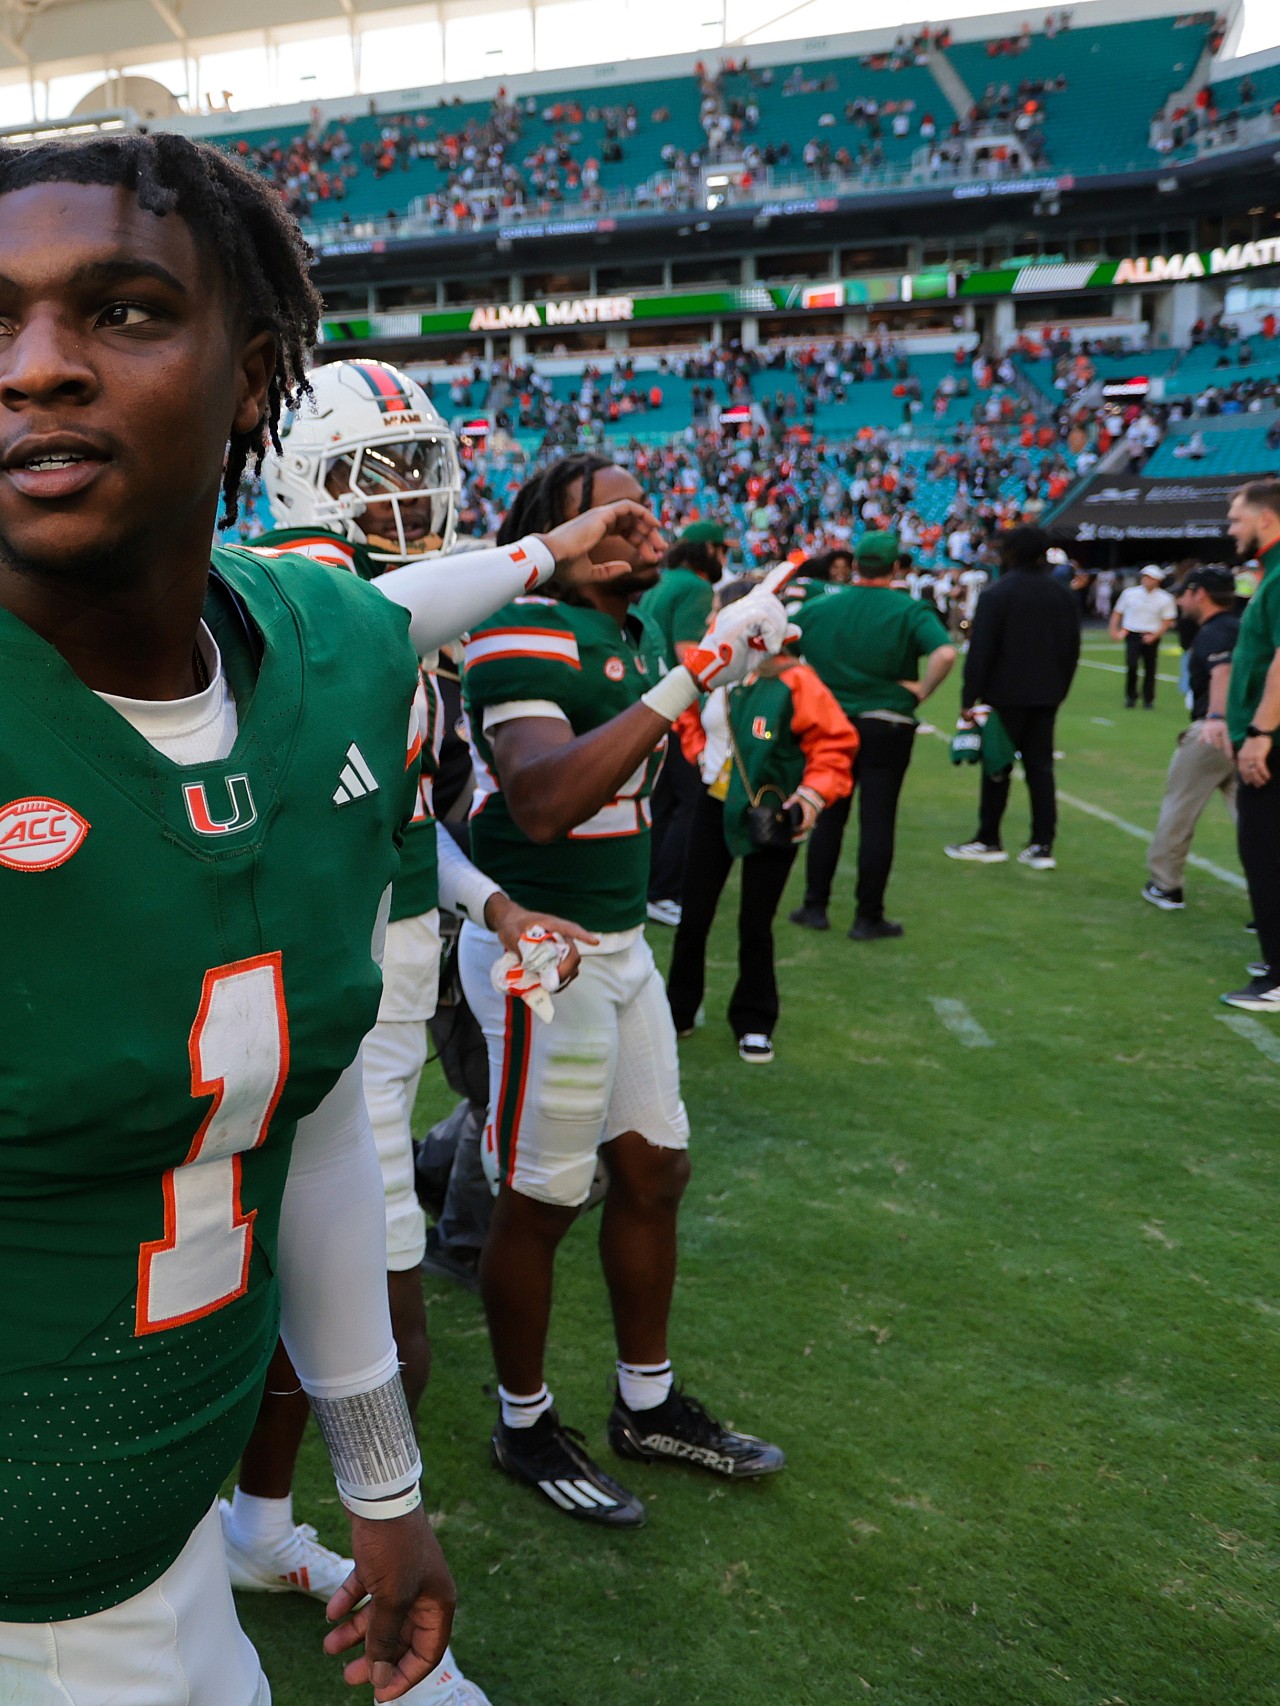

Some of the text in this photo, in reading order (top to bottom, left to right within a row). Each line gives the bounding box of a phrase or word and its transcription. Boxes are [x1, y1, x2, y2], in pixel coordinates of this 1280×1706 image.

[1112, 252, 1206, 284] ALMA
[469, 297, 634, 331] ALMA MATER
[383, 415, 422, 427] MIAMI
[182, 772, 259, 838] U
[134, 950, 292, 1338] 1
[640, 1433, 736, 1475] ADIZERO
